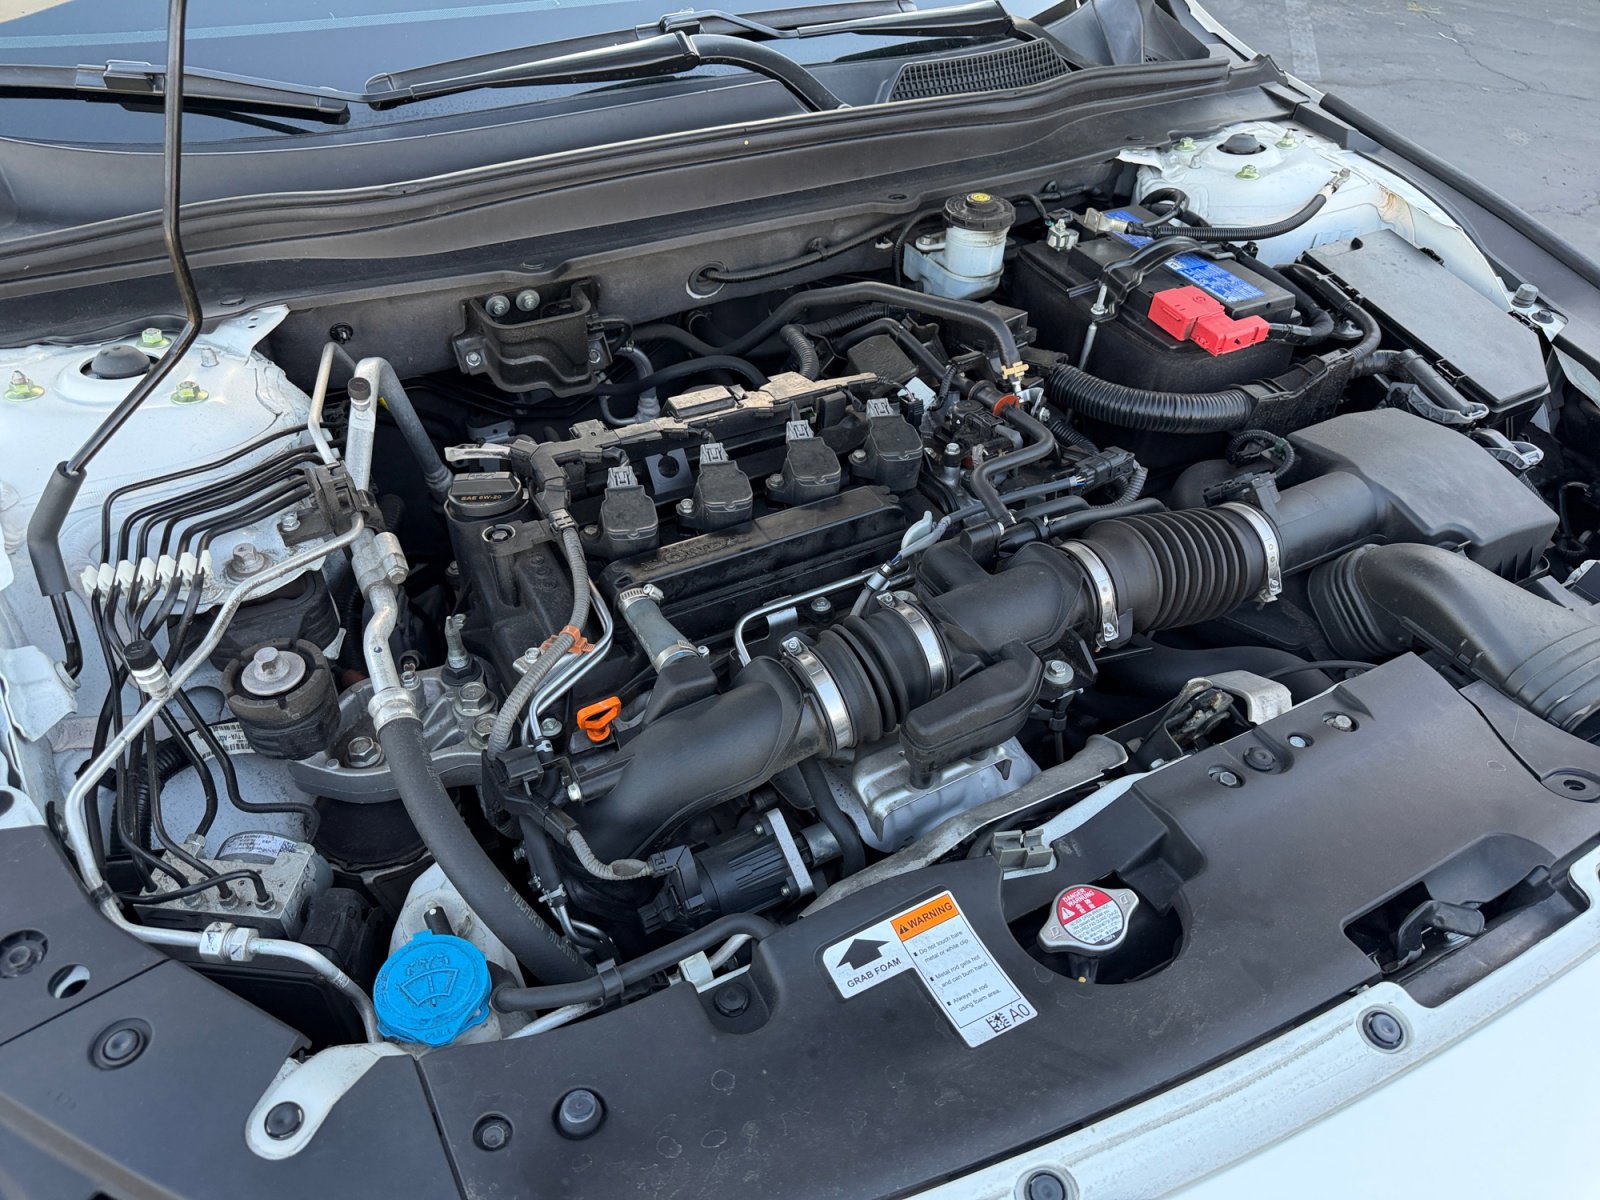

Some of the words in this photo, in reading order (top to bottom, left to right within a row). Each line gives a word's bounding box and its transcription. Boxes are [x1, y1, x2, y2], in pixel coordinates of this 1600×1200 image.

[907, 902, 953, 929] WARNING
[918, 947, 928, 955] Do
[927, 943, 936, 951] not
[935, 936, 951, 946] touch
[950, 931, 963, 939] bare
[925, 952, 940, 962] metal
[946, 943, 959, 952] white
[846, 970, 874, 988] GRAB
[874, 957, 902, 975] FOAM
[934, 969, 950, 979] Metal
[950, 964, 959, 972] rod
[959, 959, 971, 968] gets
[941, 979, 952, 988] and
[951, 975, 962, 983] can
[962, 968, 975, 977] burn
[952, 992, 972, 1003] Always
[978, 983, 988, 991] rod
[958, 1002, 975, 1012] using
[973, 995, 987, 1004] foam
[987, 989, 1001, 998] area.
[1009, 1003, 1031, 1023] A0
